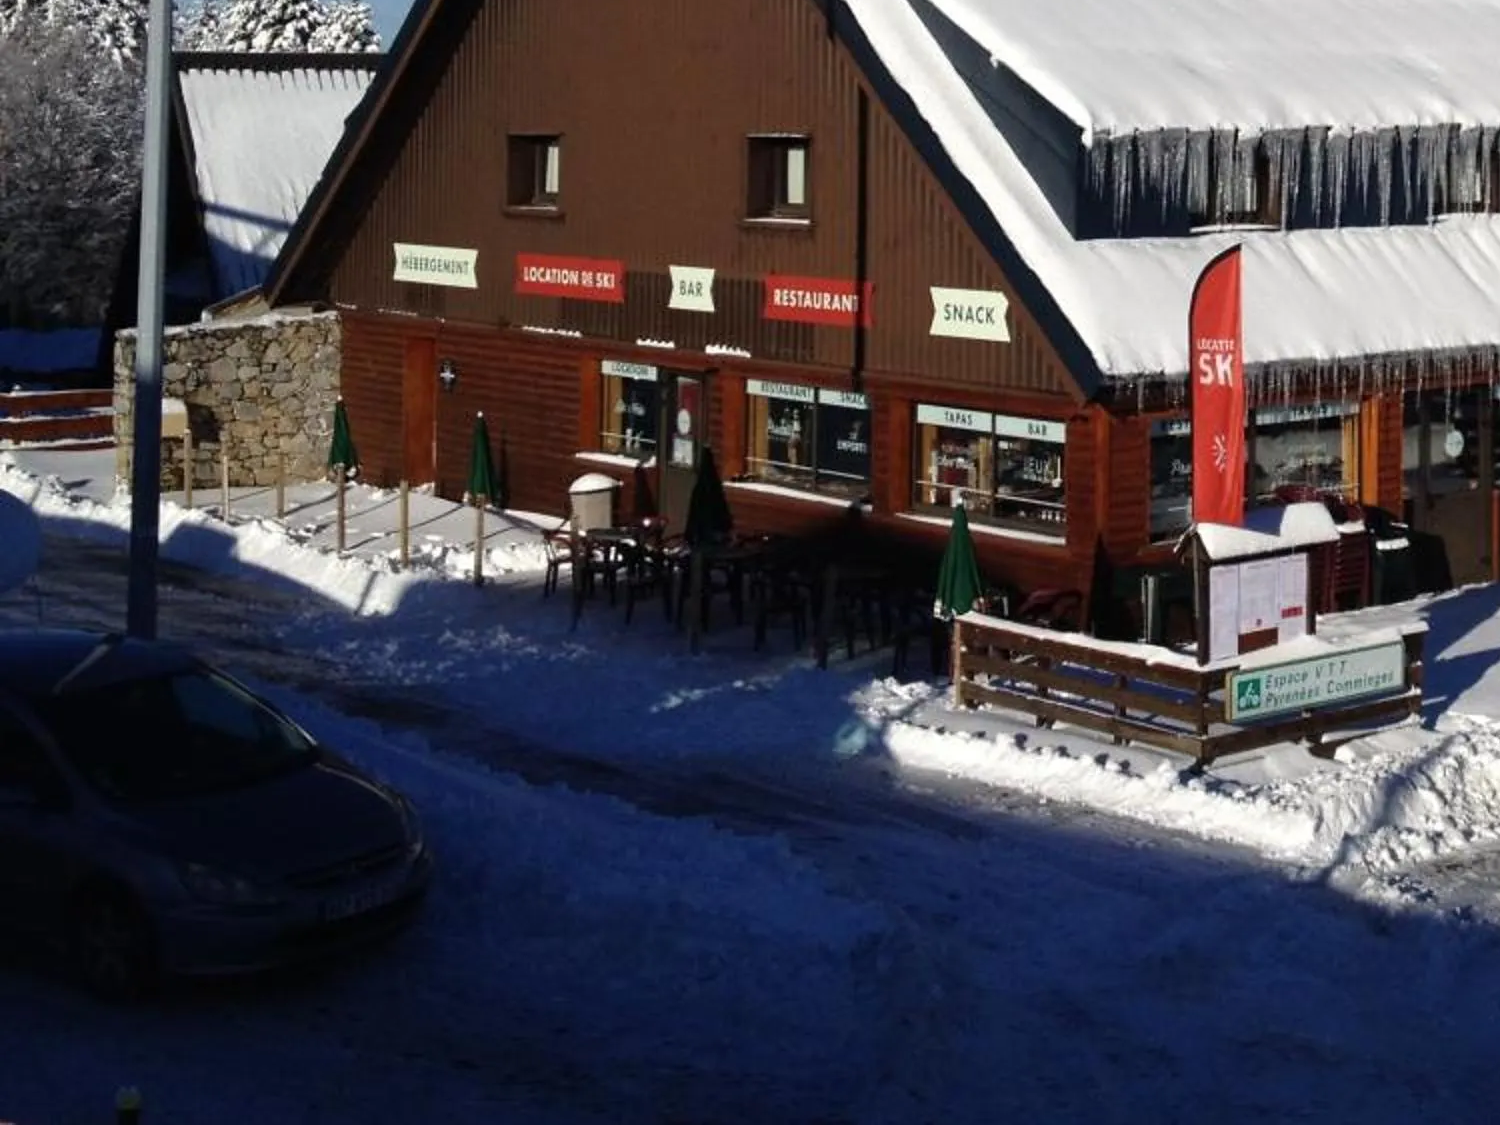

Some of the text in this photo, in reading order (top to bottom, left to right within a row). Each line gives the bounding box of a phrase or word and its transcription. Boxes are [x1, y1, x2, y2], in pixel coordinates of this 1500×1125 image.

[523, 266, 616, 289] LOCATION DE SKI
[679, 280, 703, 297] BAR
[943, 303, 996, 326] SNACK
[944, 410, 973, 426] TAPAS
[1028, 422, 1048, 436] BAR
[1264, 670, 1309, 690] Espace
